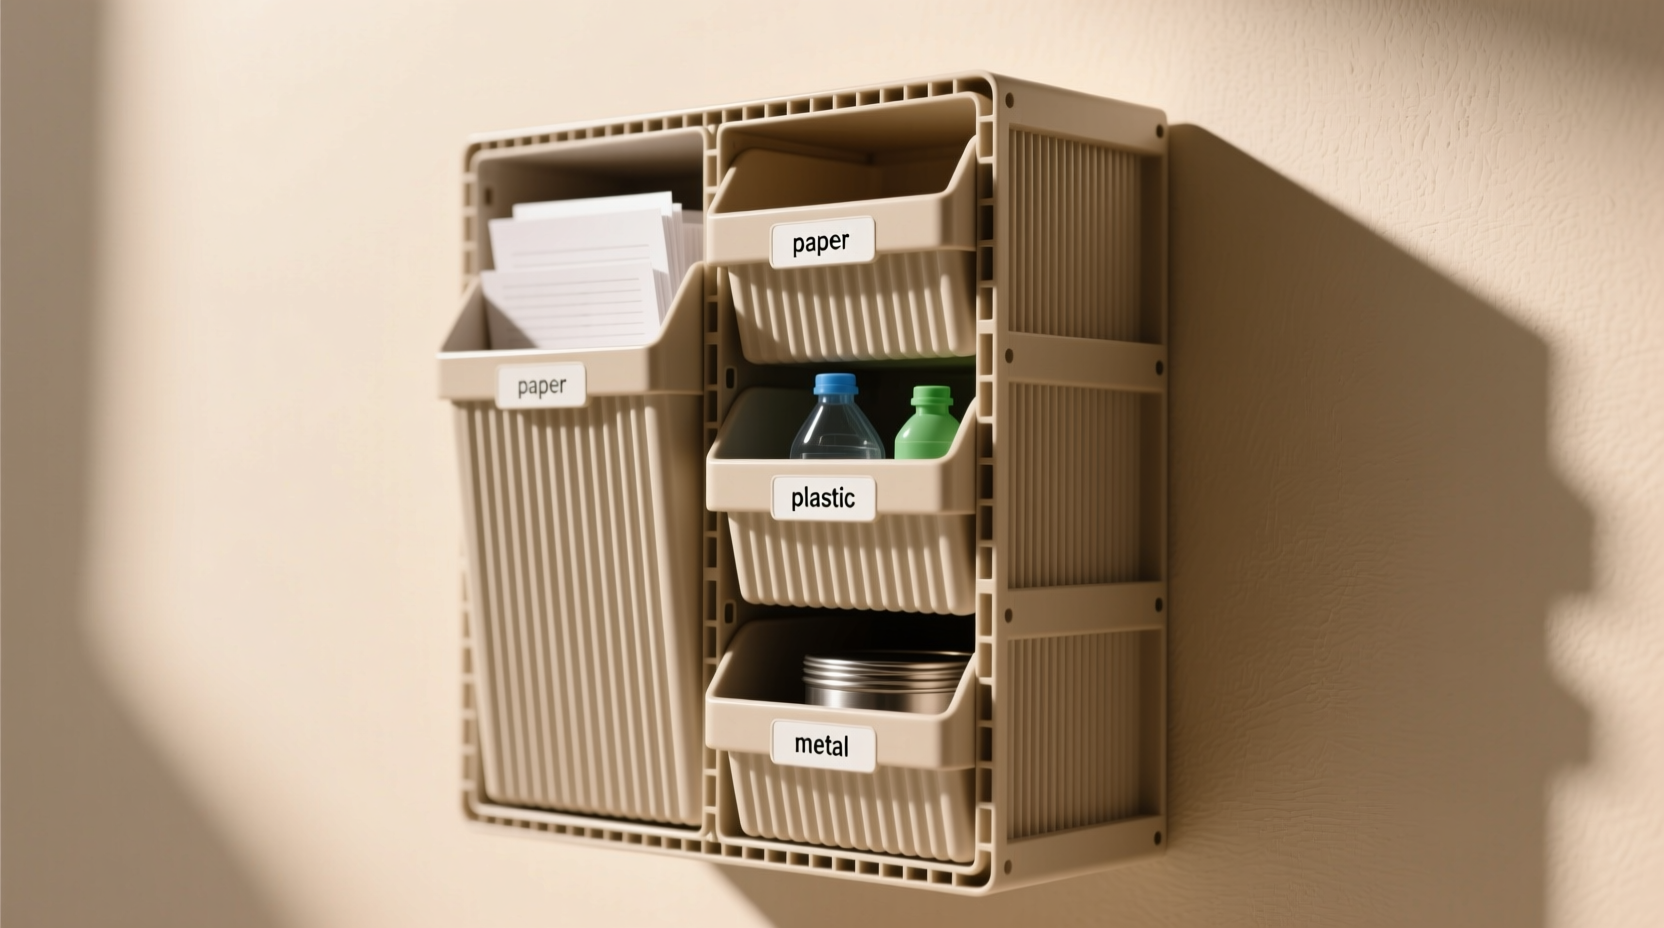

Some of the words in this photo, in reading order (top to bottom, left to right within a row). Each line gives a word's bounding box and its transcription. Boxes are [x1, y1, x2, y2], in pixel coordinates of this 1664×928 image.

[793, 233, 850, 258] paper
[518, 378, 567, 399] paper
[791, 486, 856, 511] plastic
[795, 735, 849, 758] metal
